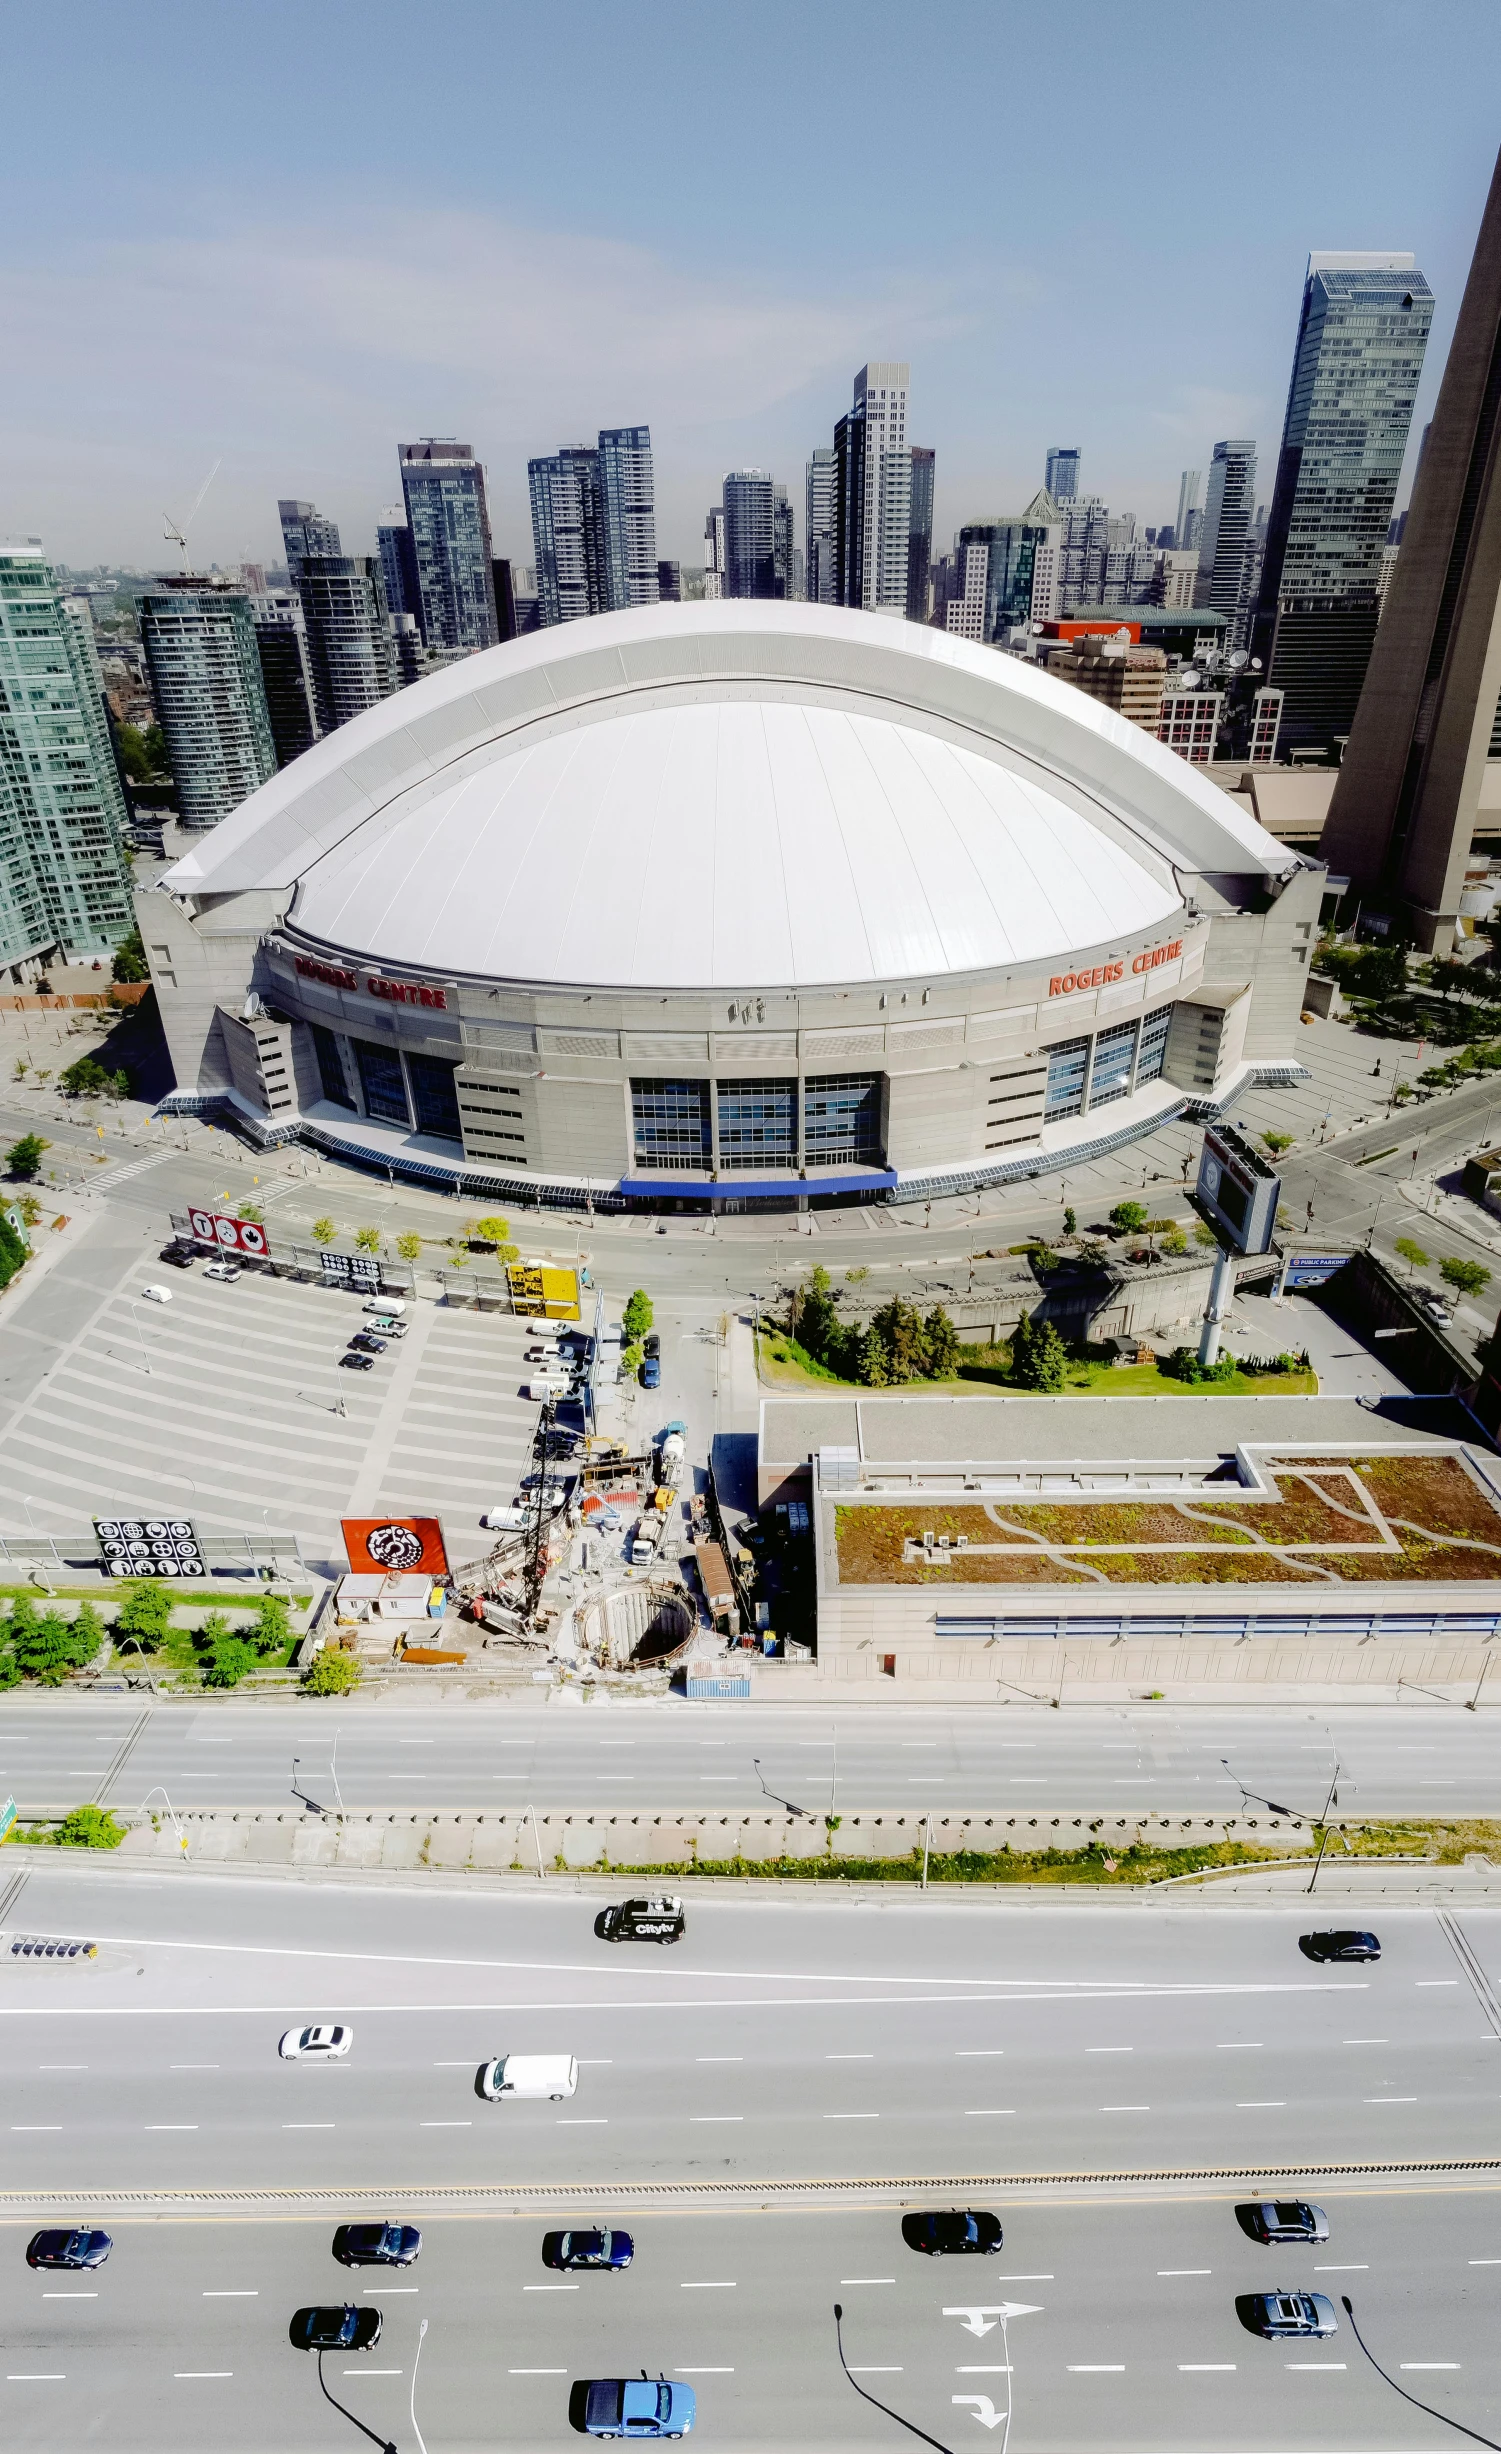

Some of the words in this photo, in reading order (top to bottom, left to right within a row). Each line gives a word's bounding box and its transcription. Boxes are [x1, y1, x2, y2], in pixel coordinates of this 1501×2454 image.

[1049, 961, 1124, 997] ROGERS
[1132, 939, 1183, 974] CENTRE
[367, 976, 448, 1010] CENTRE
[635, 1923, 674, 1935] Citytv
